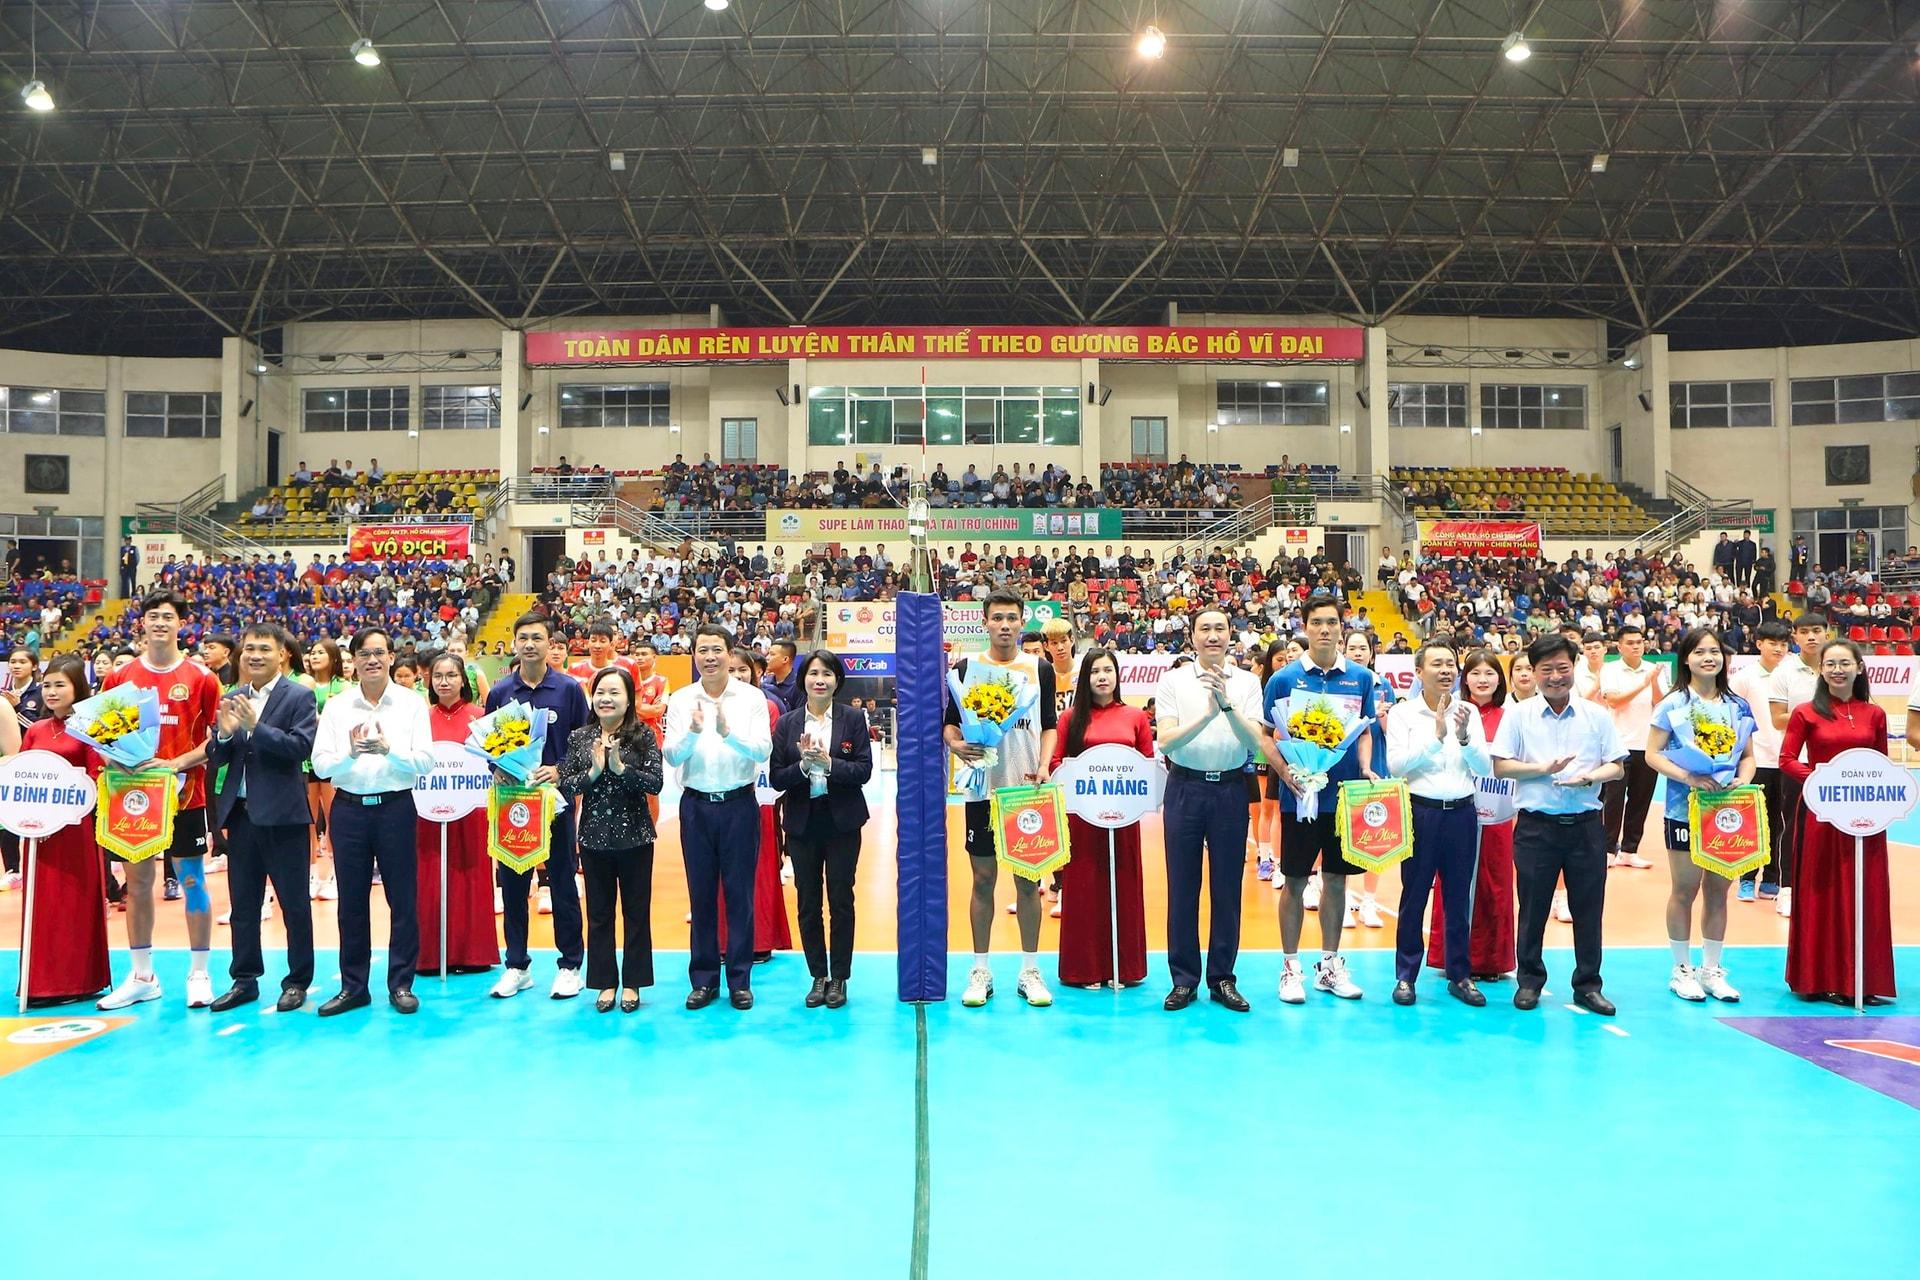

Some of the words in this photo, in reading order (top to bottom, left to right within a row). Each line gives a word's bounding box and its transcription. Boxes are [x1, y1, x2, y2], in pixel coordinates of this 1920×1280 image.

[565, 334, 629, 357] TOÀN
[639, 333, 690, 356] DÂN
[700, 332, 750, 354] RÈN
[758, 332, 839, 357] LUYỆN
[848, 331, 915, 353] THÂN
[924, 328, 970, 353] THỂ
[978, 335, 1042, 353] THEO
[1051, 333, 1139, 353] GƯƠNG
[1148, 332, 1199, 353] BÁC
[1208, 329, 1241, 354] HỒ
[1249, 332, 1273, 353] VĨ
[1280, 335, 1324, 357] ĐẠI
[819, 519, 847, 530] SUPE
[851, 517, 874, 530] LÂM
[878, 519, 905, 530] THAO
[941, 516, 957, 530] TÀI
[961, 518, 981, 532] TRỢ
[985, 516, 1019, 530] CHÍNH
[372, 537, 398, 556] VÔ
[1491, 539, 1512, 547] CHIẾN
[877, 624, 897, 635] CÚ
[844, 658, 888, 671] VTVcab
[42, 772, 59, 780] VĐV
[1089, 764, 1113, 772] ĐOÀN
[1116, 765, 1134, 773] VĐV
[1841, 769, 1864, 778] ĐOÀN
[1866, 770, 1883, 778] VĐV
[431, 775, 447, 790] AN
[451, 774, 493, 790] TPHCM
[1075, 775, 1097, 795] ĐÀ
[1103, 773, 1148, 795] NẴNG
[1481, 777, 1508, 795] NINH
[0, 784, 9, 801] V
[13, 782, 48, 803] BÌNH
[1819, 785, 1907, 802] VIETINBANK
[968, 829, 974, 843] 3
[1675, 828, 1688, 842] 10
